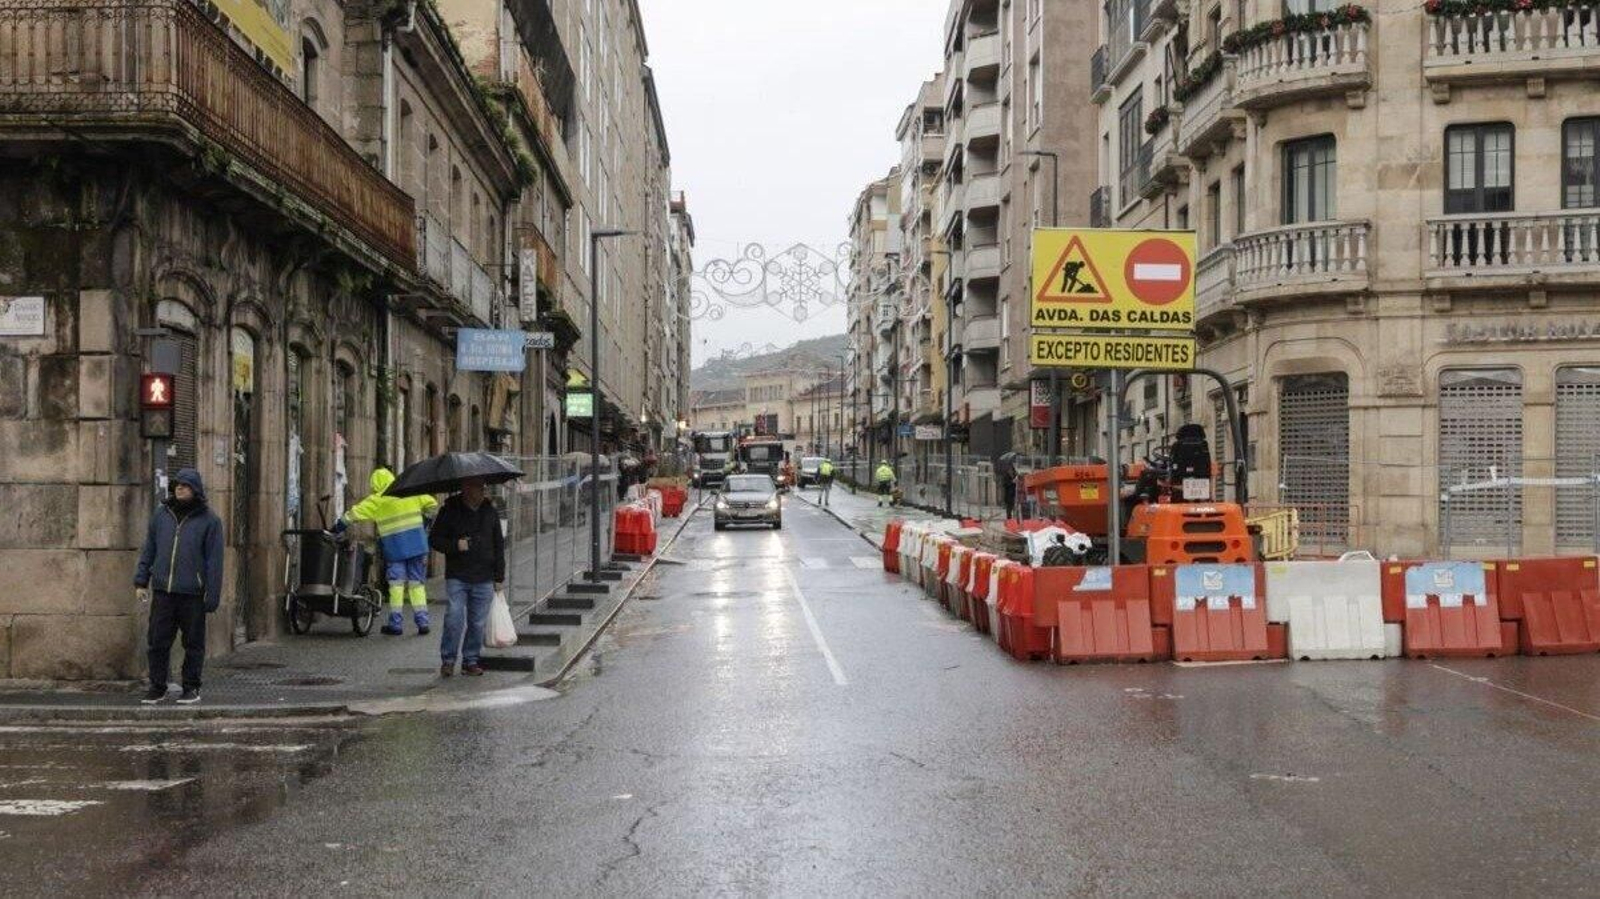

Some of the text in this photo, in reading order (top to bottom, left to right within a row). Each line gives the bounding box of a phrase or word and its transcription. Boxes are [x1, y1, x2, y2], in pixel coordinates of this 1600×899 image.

[1035, 308, 1192, 324] AVDA. DAS CALDAS
[1037, 340, 1190, 364] EXCEPTO RESIDENTES
